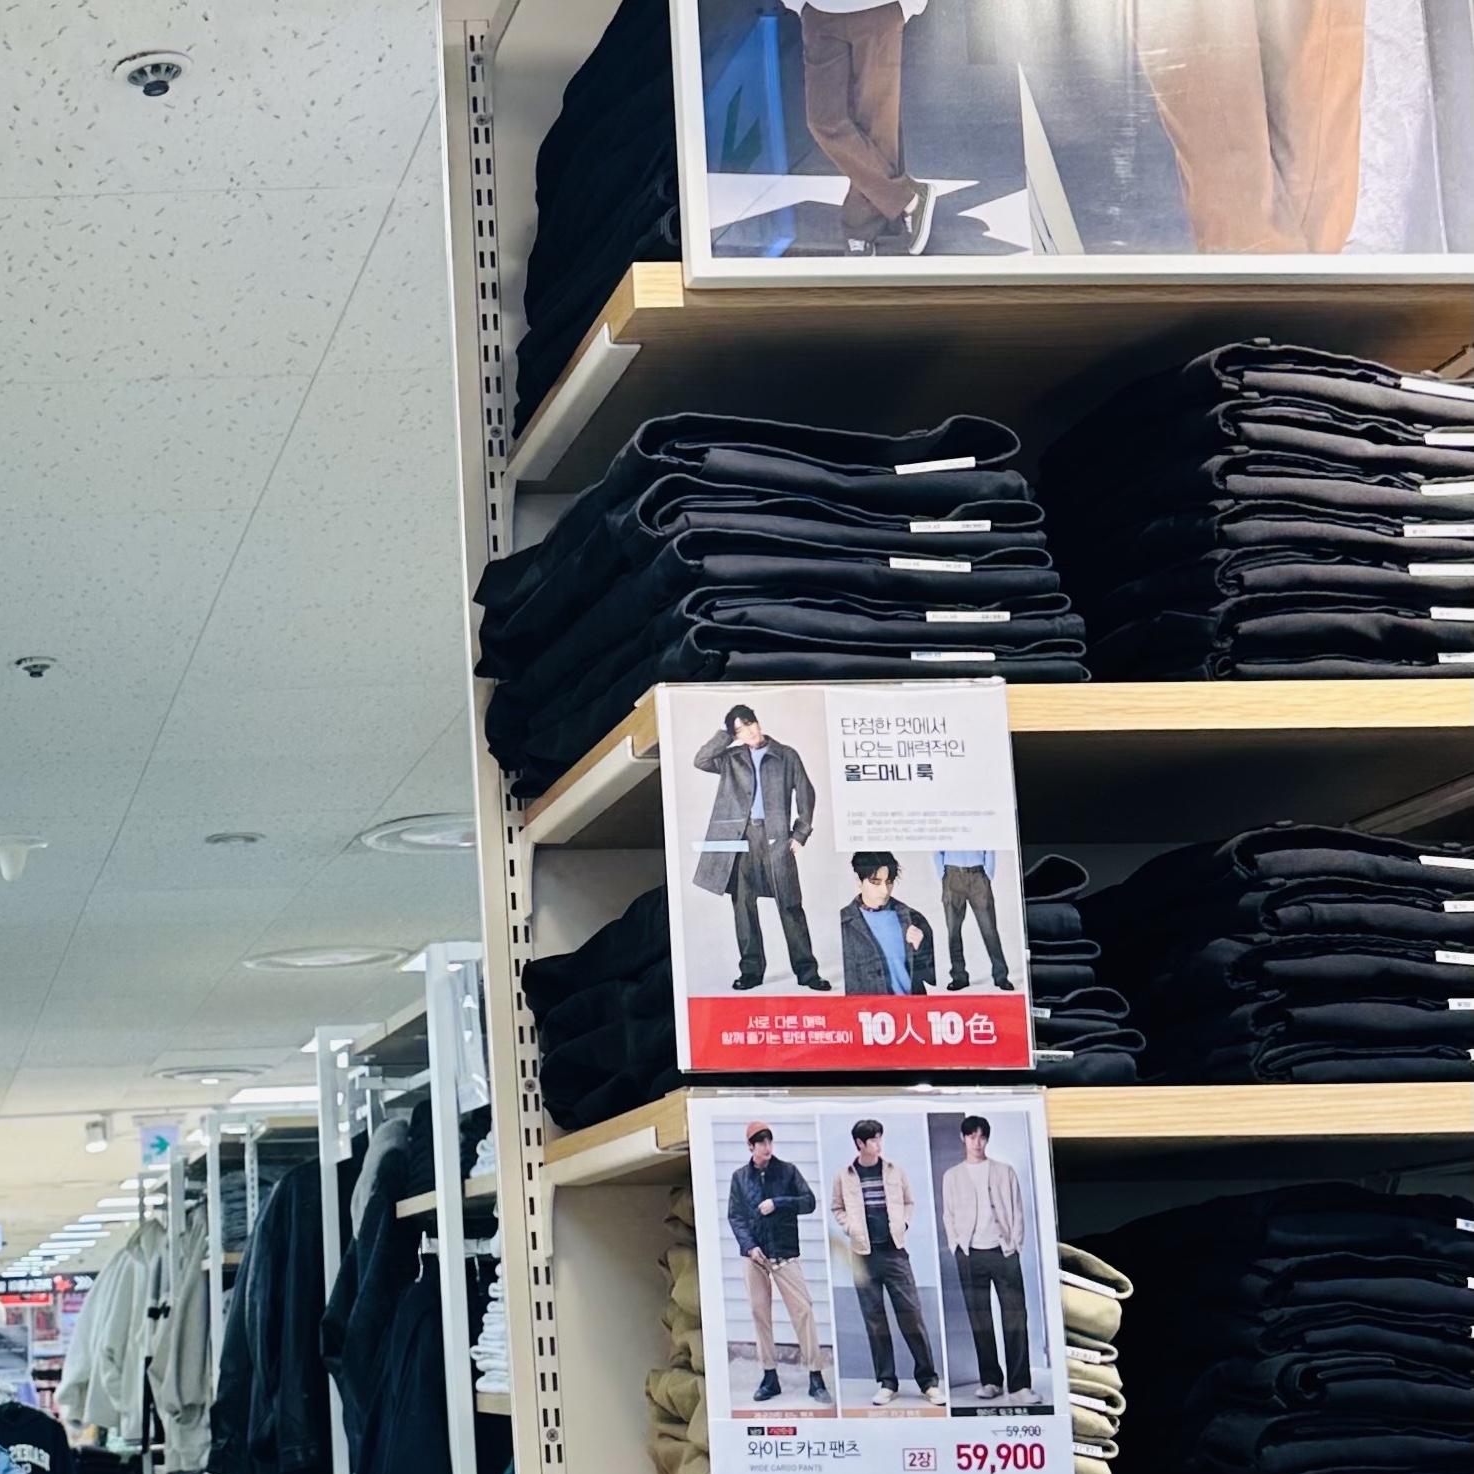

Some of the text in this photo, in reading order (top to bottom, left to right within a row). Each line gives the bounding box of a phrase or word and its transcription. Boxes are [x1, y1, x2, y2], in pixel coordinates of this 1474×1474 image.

[841, 717, 947, 735] 단정한 멋에서
[842, 739, 966, 759] 나오는 매력적인
[844, 763, 934, 782] 올드머니 룩
[747, 1015, 771, 1029] 서로
[774, 1015, 798, 1029] 다른
[858, 1011, 997, 1045] 10人10色
[721, 1031, 745, 1045] 함께
[746, 1031, 781, 1045] 즐기는
[1006, 1425, 1042, 1438] 59,900
[747, 1440, 862, 1459] 와이드 카고 팬츠
[956, 1443, 1046, 1474] 59,900
[749, 1464, 823, 1472] WIDE CARGO PANTS
[908, 1452, 932, 1468] 2장
